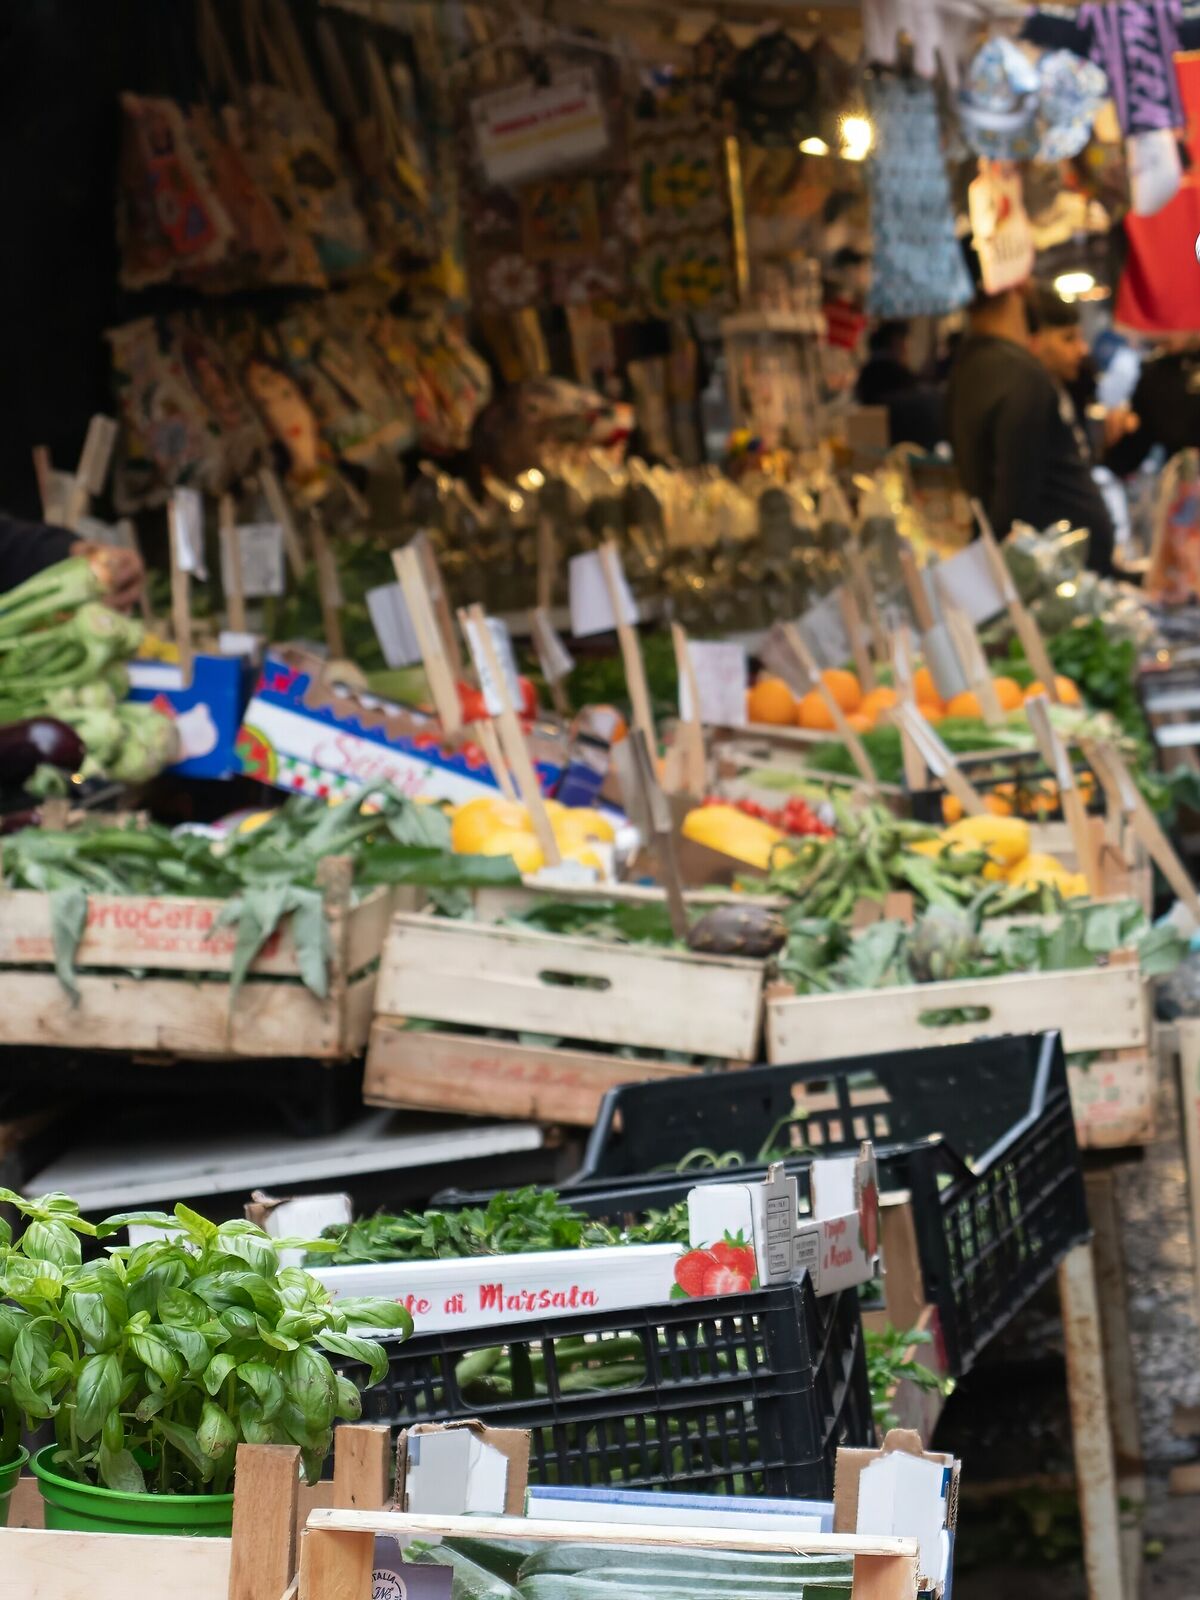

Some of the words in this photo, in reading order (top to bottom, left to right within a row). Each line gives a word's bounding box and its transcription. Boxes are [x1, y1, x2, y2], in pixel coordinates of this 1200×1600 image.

[444, 1293, 466, 1314] di
[479, 1283, 599, 1313] Marsala
[371, 1572, 396, 1583] TALIA
